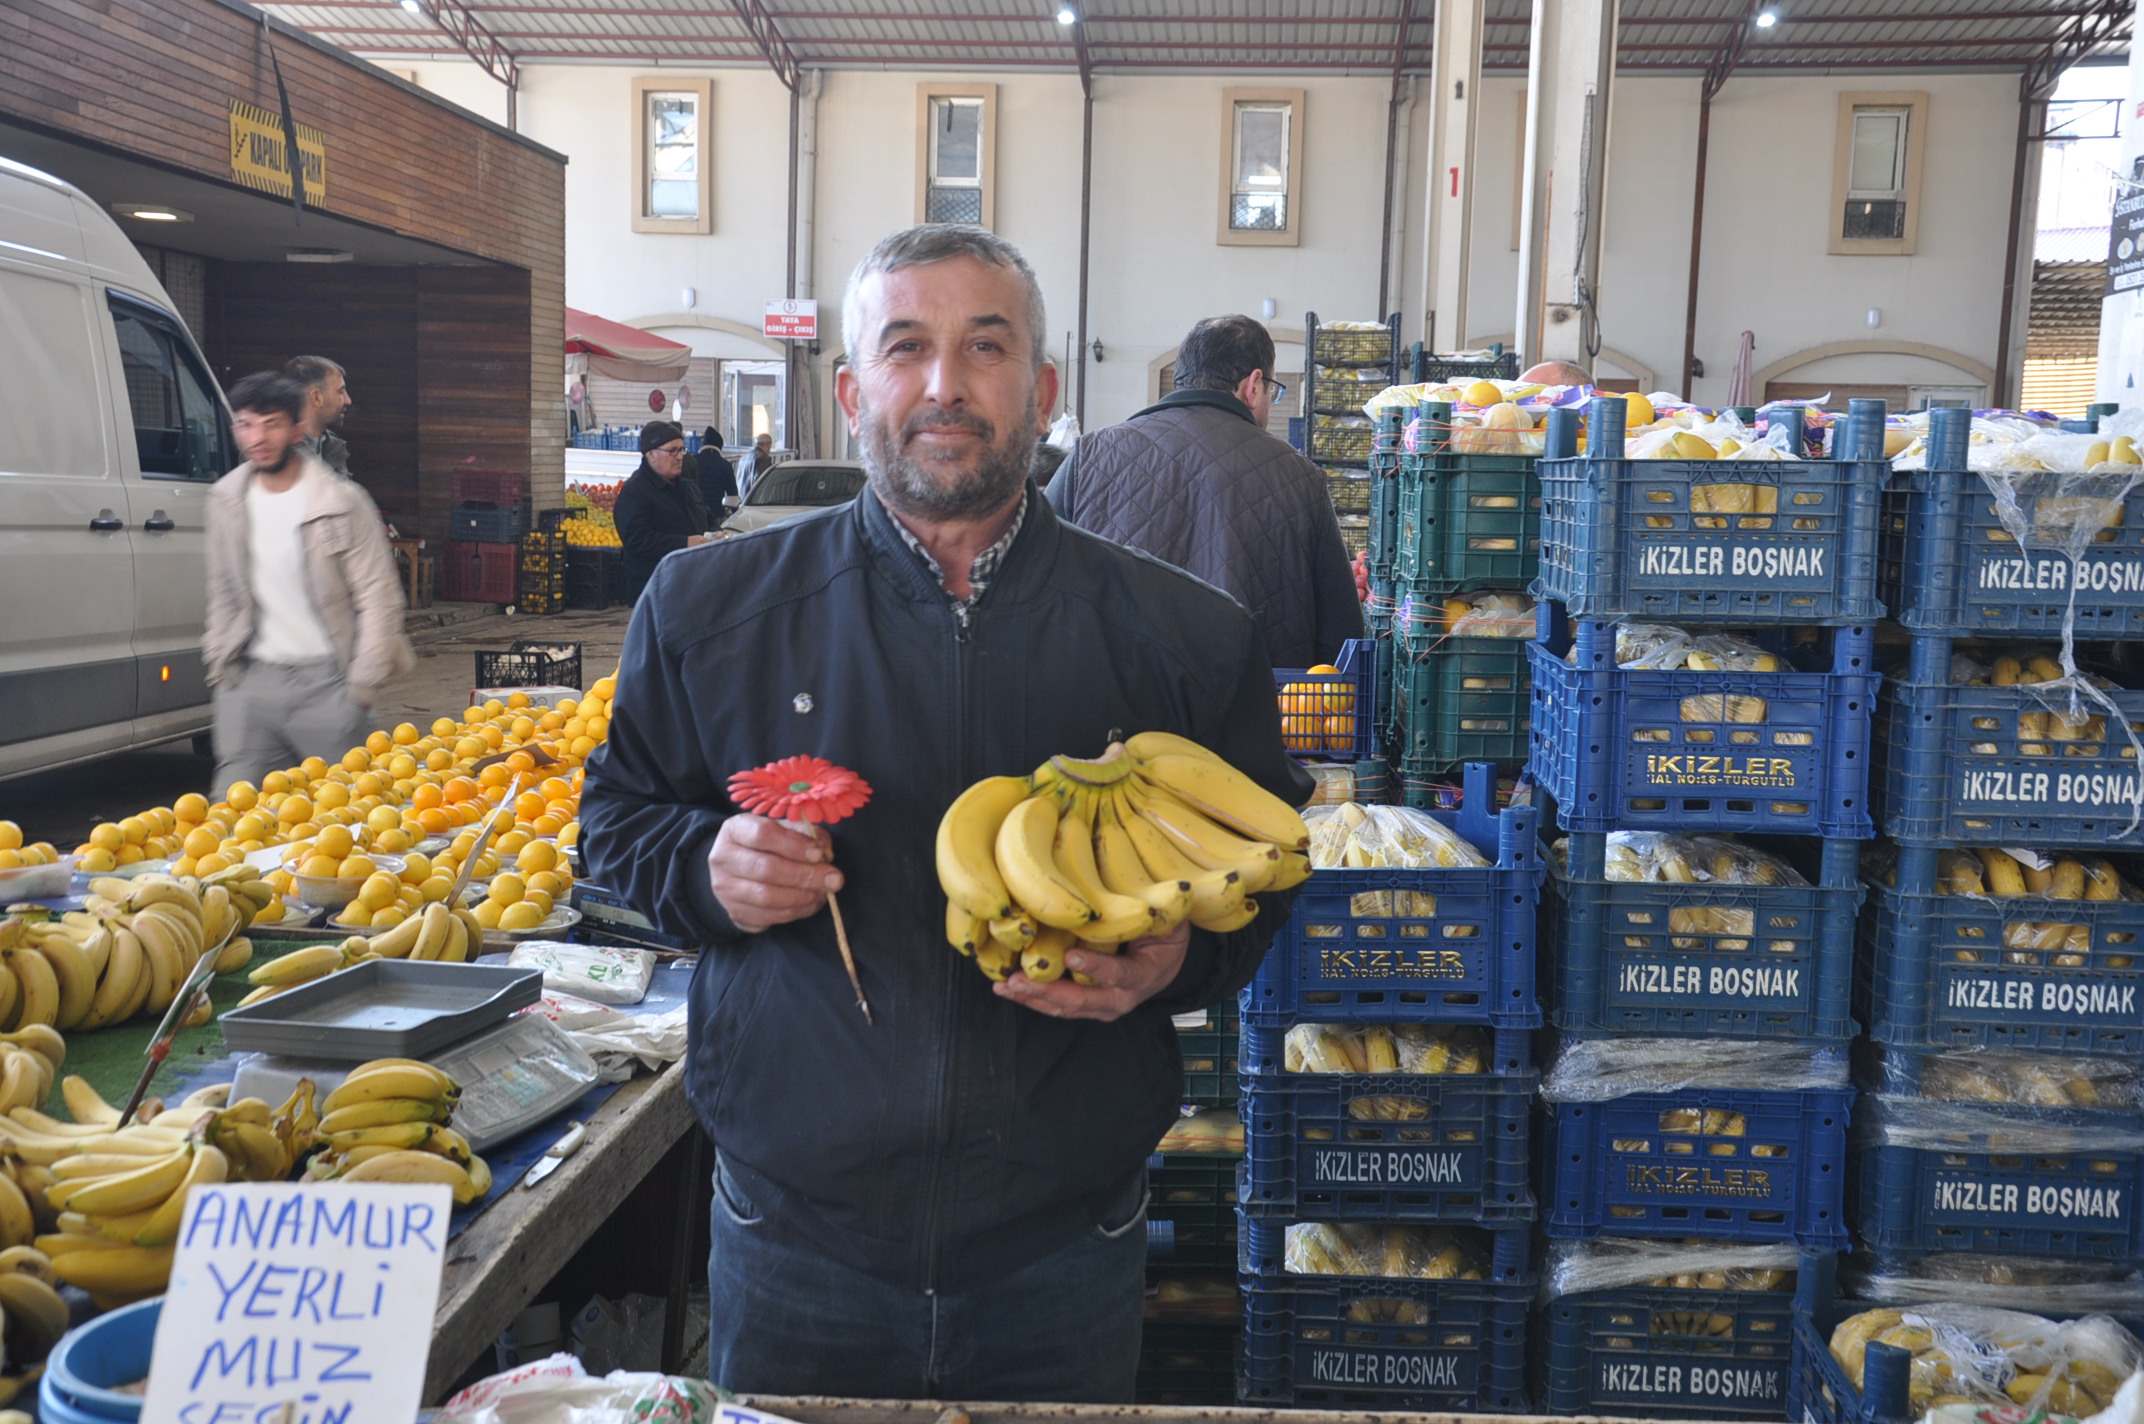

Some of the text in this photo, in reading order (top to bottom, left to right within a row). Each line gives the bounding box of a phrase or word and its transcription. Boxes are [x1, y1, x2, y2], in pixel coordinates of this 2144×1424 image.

[250, 131, 323, 185] KAPALI OPARK
[1449, 167, 1459, 197] 1
[1732, 546, 1825, 578] BOŞNAK
[2057, 773, 2142, 806] BOŞNA
[1709, 967, 1799, 998] BOŞNAK
[2042, 983, 2136, 1015] BOŞNAK
[2027, 1185, 2121, 1218] BOŞNAK
[184, 1190, 438, 1253] ANAMUR
[189, 1335, 373, 1392] MUZ
[1690, 1367, 1778, 1398] BOŞNAK
